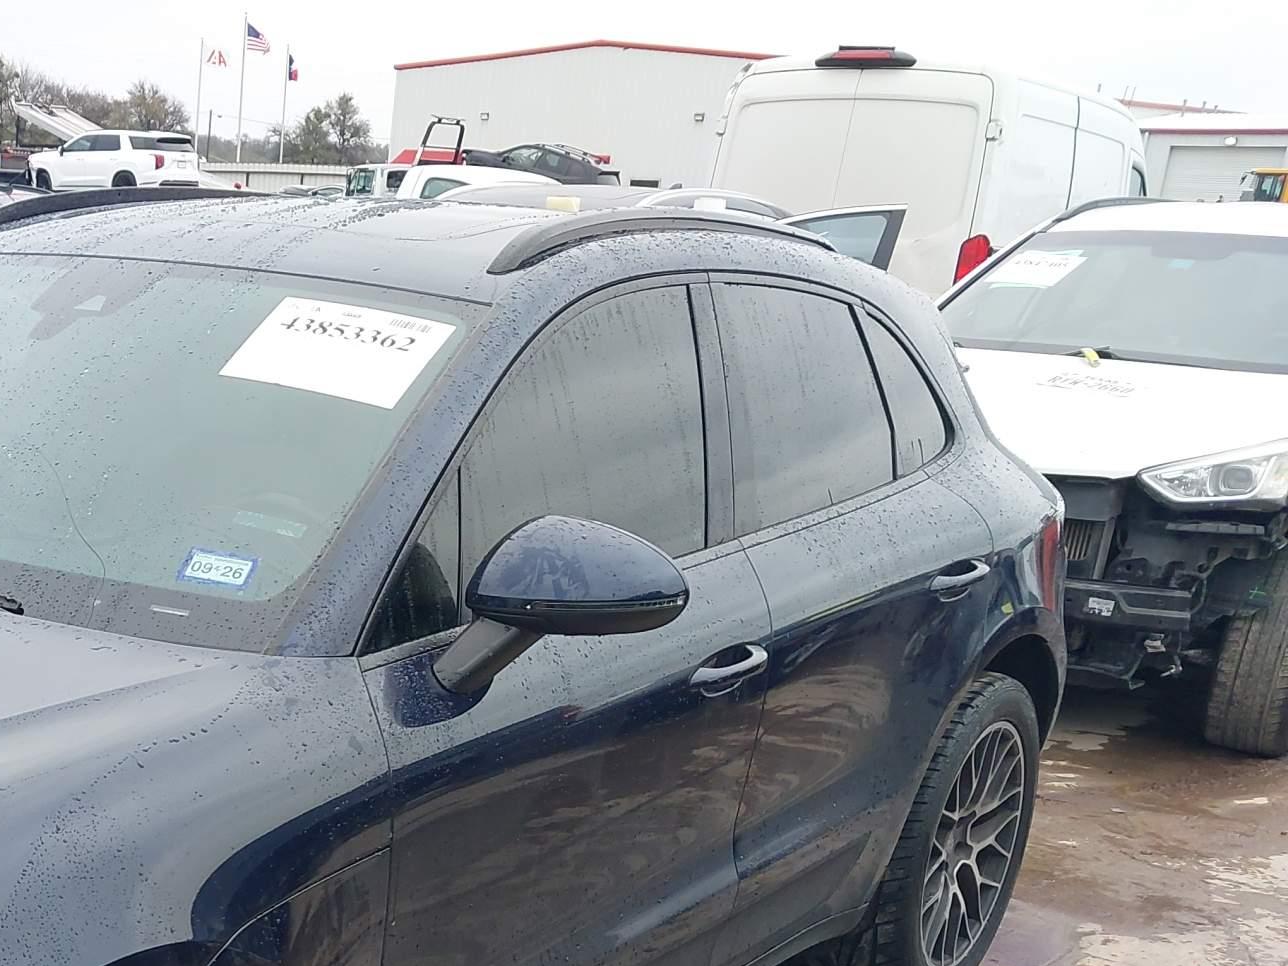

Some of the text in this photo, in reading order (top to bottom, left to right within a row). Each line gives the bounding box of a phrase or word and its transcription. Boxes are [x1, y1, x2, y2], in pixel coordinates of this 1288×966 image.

[280, 316, 416, 352] 43853362
[191, 560, 214, 574] 09
[220, 566, 245, 579] 26
